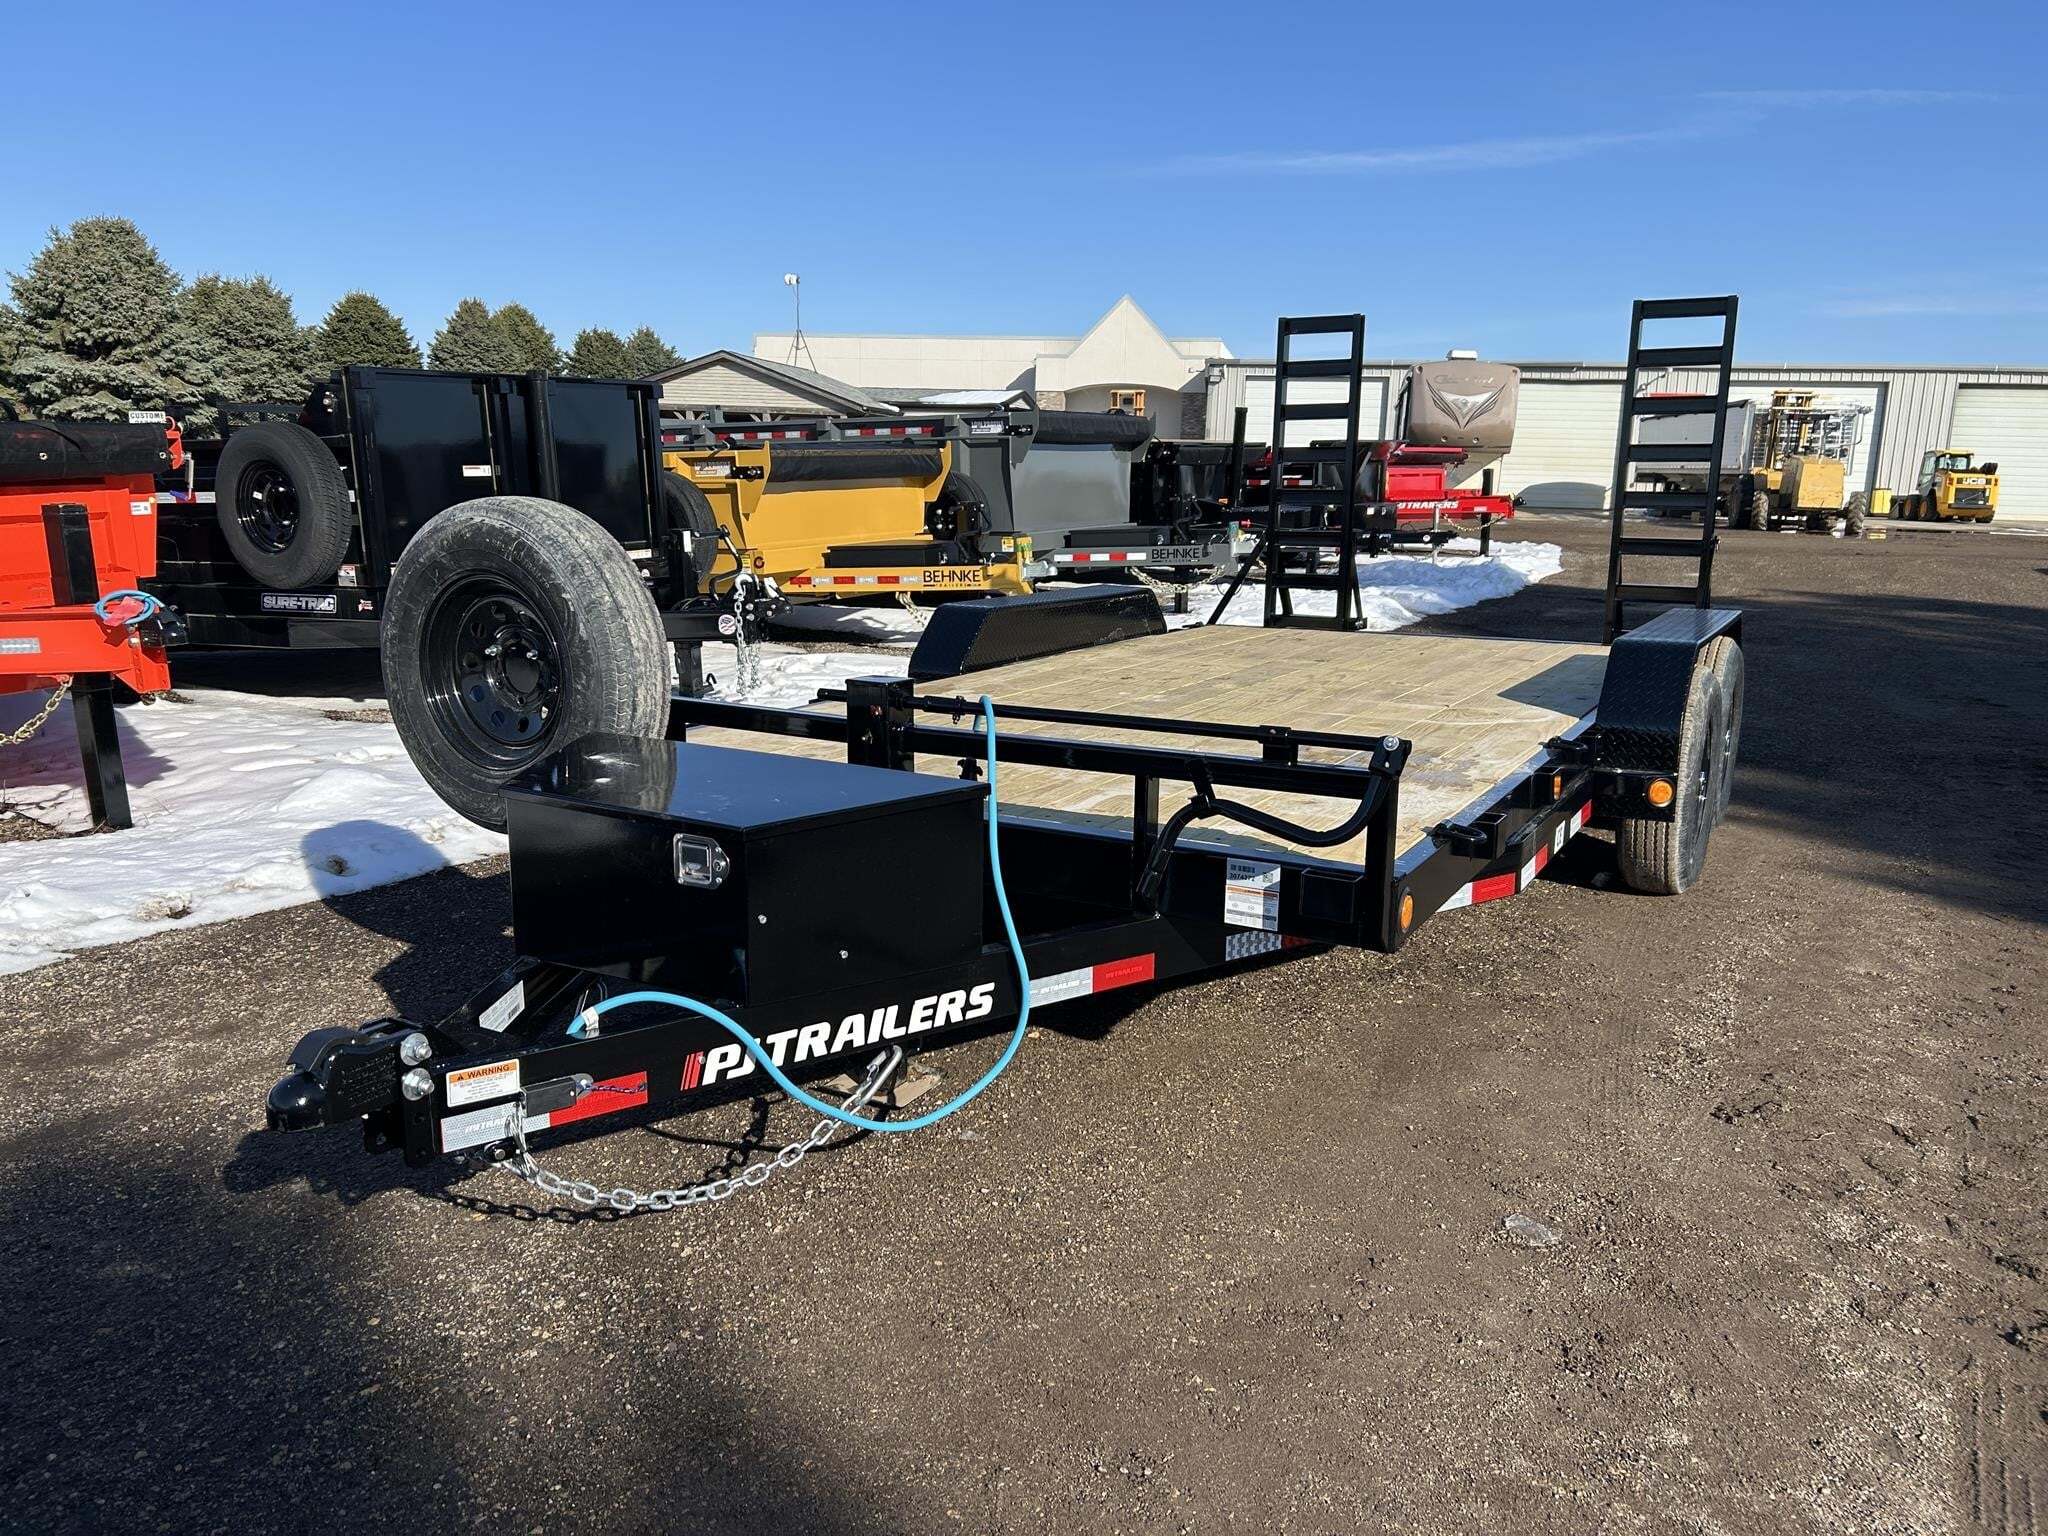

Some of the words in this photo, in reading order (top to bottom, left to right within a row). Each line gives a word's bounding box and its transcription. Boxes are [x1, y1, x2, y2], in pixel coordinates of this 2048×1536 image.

[1151, 547, 1200, 560] BEHNKE
[923, 569, 981, 583] BEHNKE
[263, 595, 335, 611] SURE-TRAC
[764, 982, 995, 1067] TRAILERS
[467, 1064, 510, 1079] WARNING
